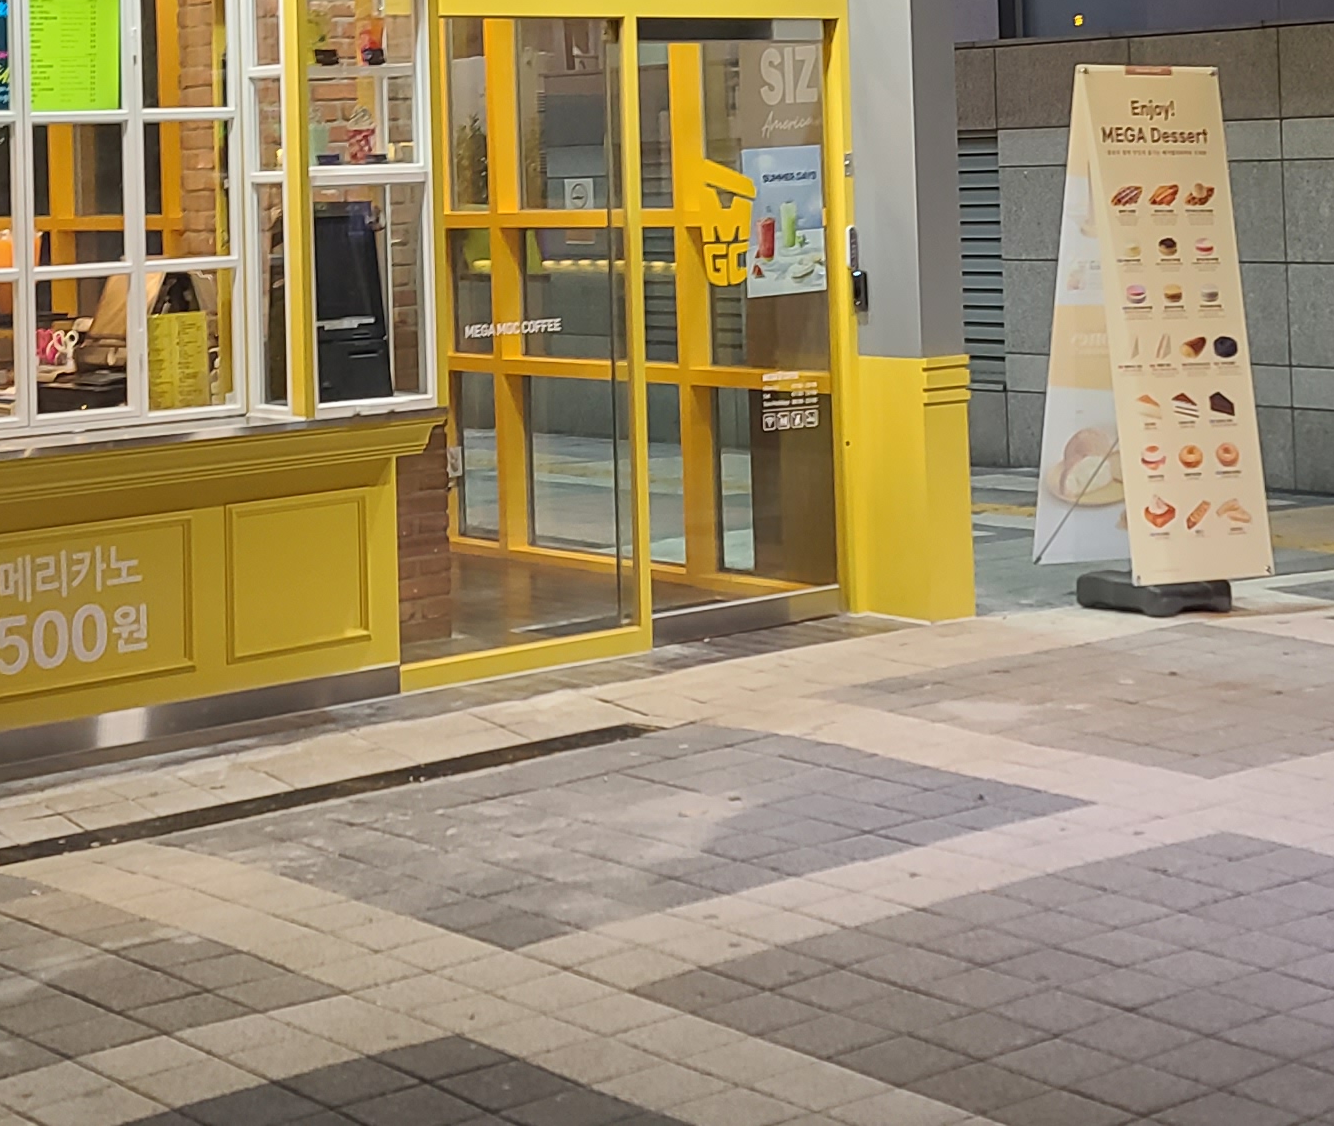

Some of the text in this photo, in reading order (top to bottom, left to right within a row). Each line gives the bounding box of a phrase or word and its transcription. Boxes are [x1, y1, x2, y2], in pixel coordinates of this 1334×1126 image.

[760, 44, 822, 106] SIZ
[1130, 99, 1176, 121] Enjoy!
[1101, 127, 1209, 144] MEGA Dessert
[464, 323, 495, 339] MEGA
[521, 317, 563, 334] COFFEE
